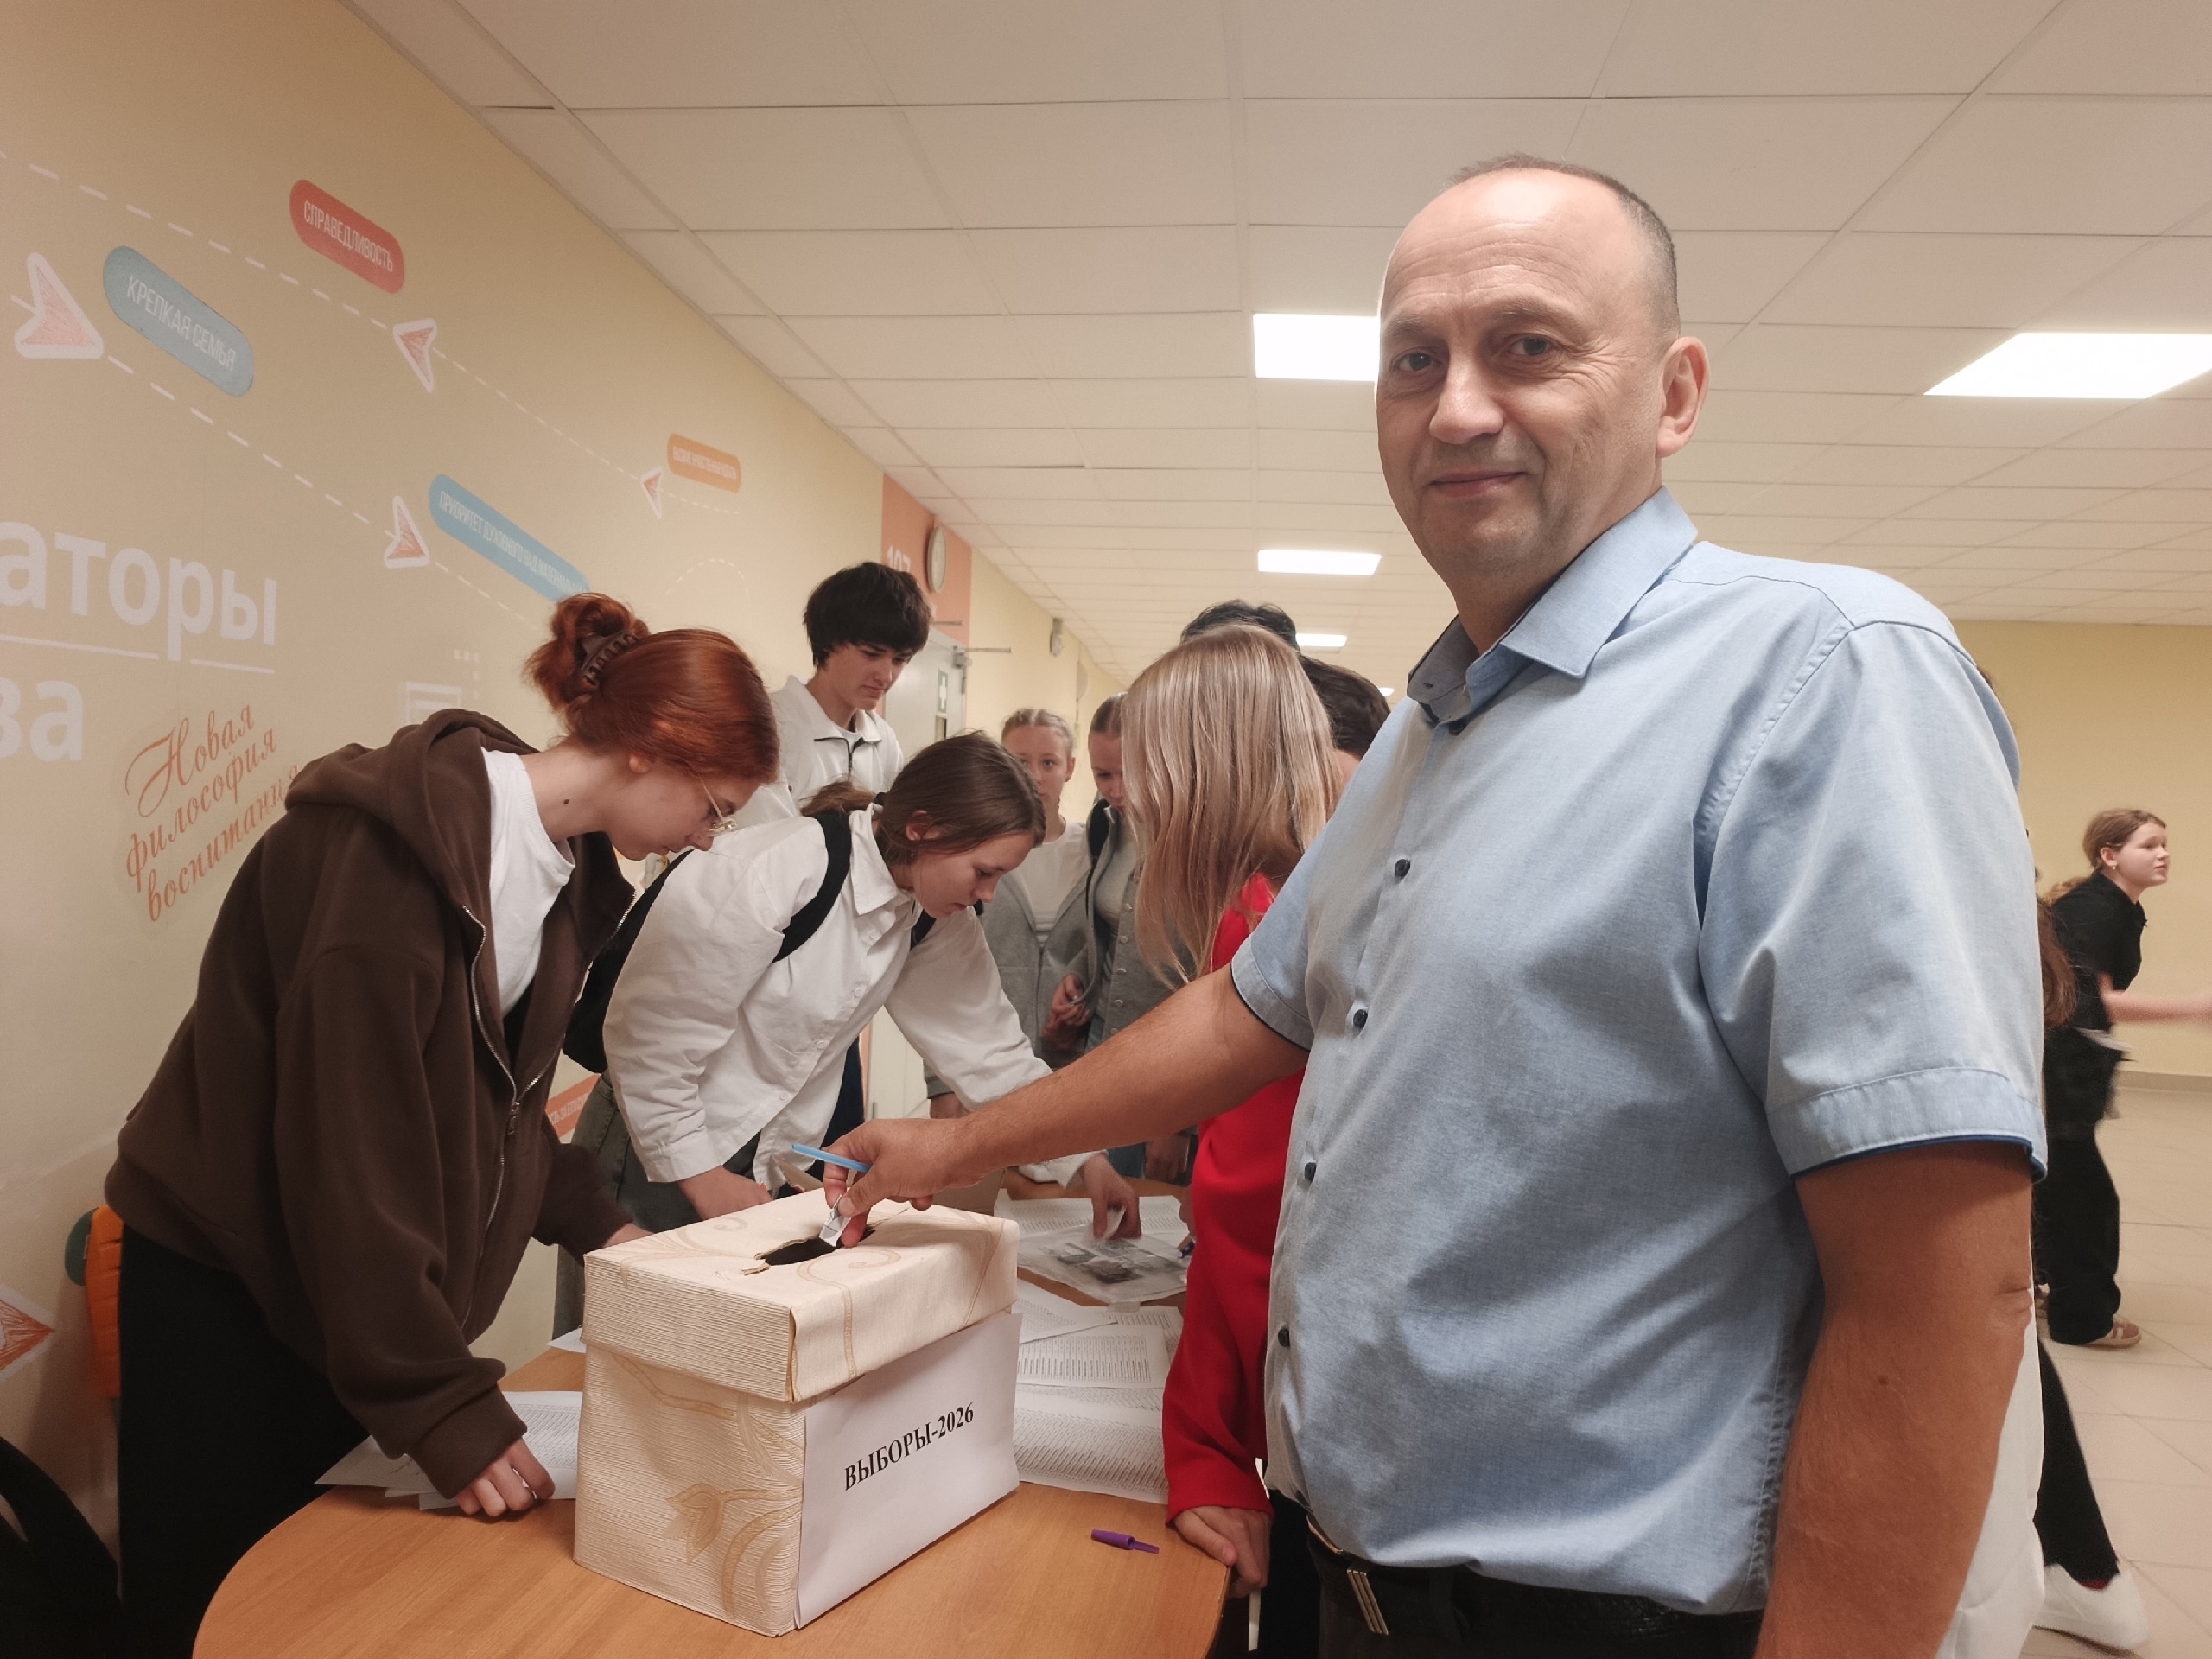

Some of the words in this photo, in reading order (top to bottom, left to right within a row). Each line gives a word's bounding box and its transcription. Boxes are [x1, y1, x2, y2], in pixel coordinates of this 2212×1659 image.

[303, 200, 394, 273] СПРАВЕДЛИВОСТЬ
[126, 275, 192, 340] КРЕПКАЯ
[192, 323, 236, 372] СЕМЬЯ
[439, 490, 483, 535] ПРИОРИТЕТ
[125, 704, 255, 817] Новая
[126, 728, 276, 893] философия
[844, 1401, 974, 1491] ВЫБОРЫ-2026
